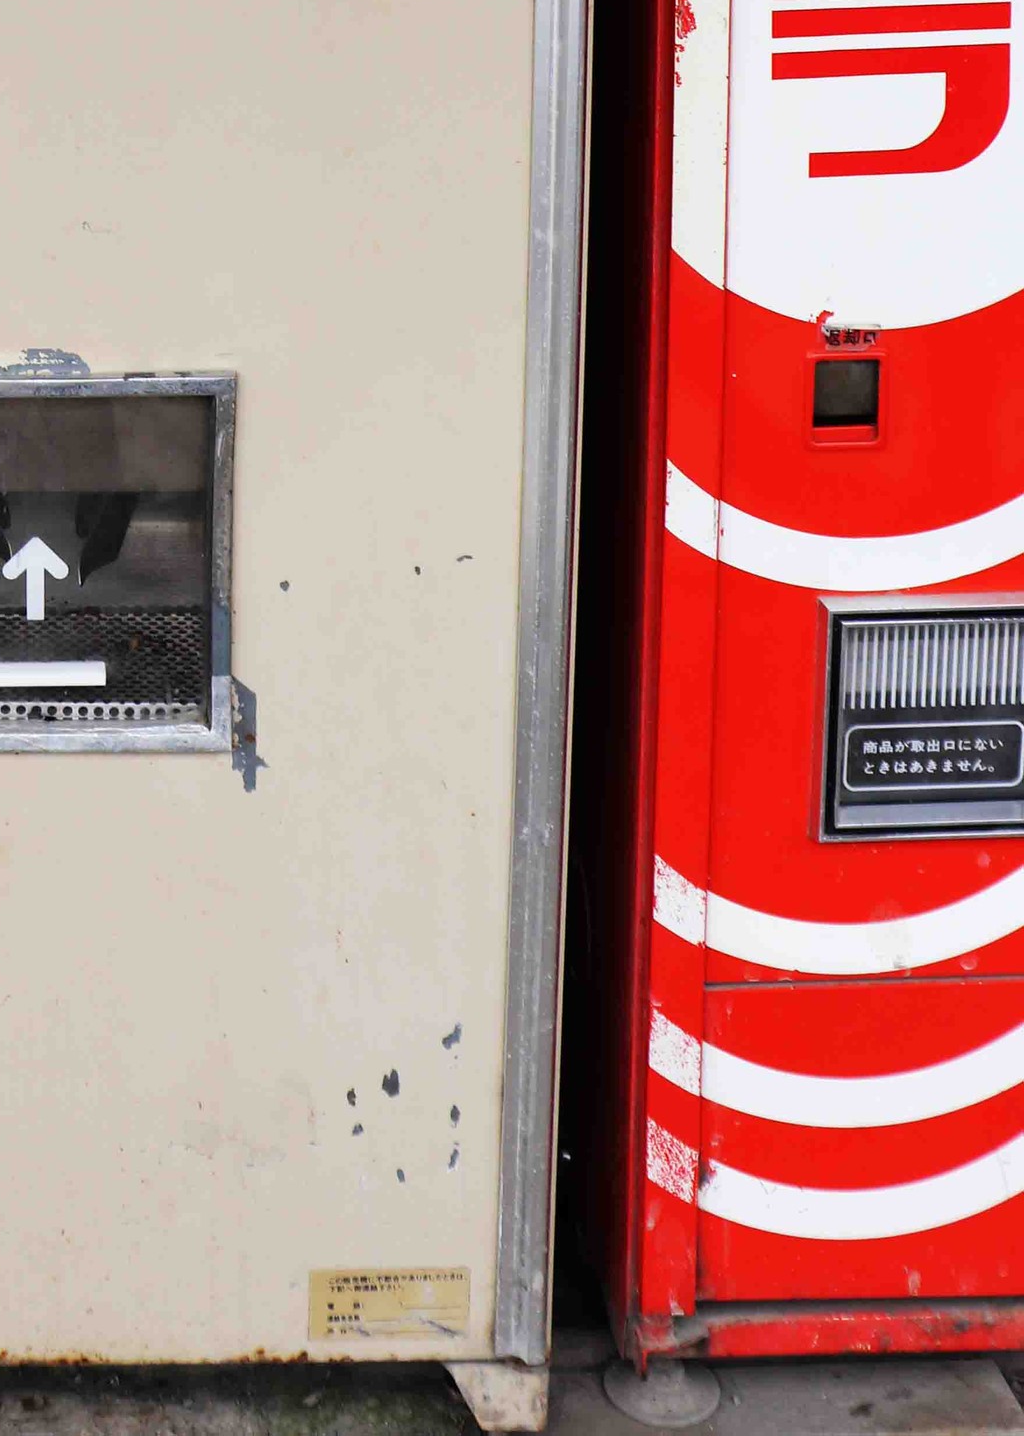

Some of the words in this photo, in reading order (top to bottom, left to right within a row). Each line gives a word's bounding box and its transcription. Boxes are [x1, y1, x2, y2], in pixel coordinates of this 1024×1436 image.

[862, 738, 1004, 755] 商品が取出口にない
[863, 759, 995, 775] ときはあきません。
